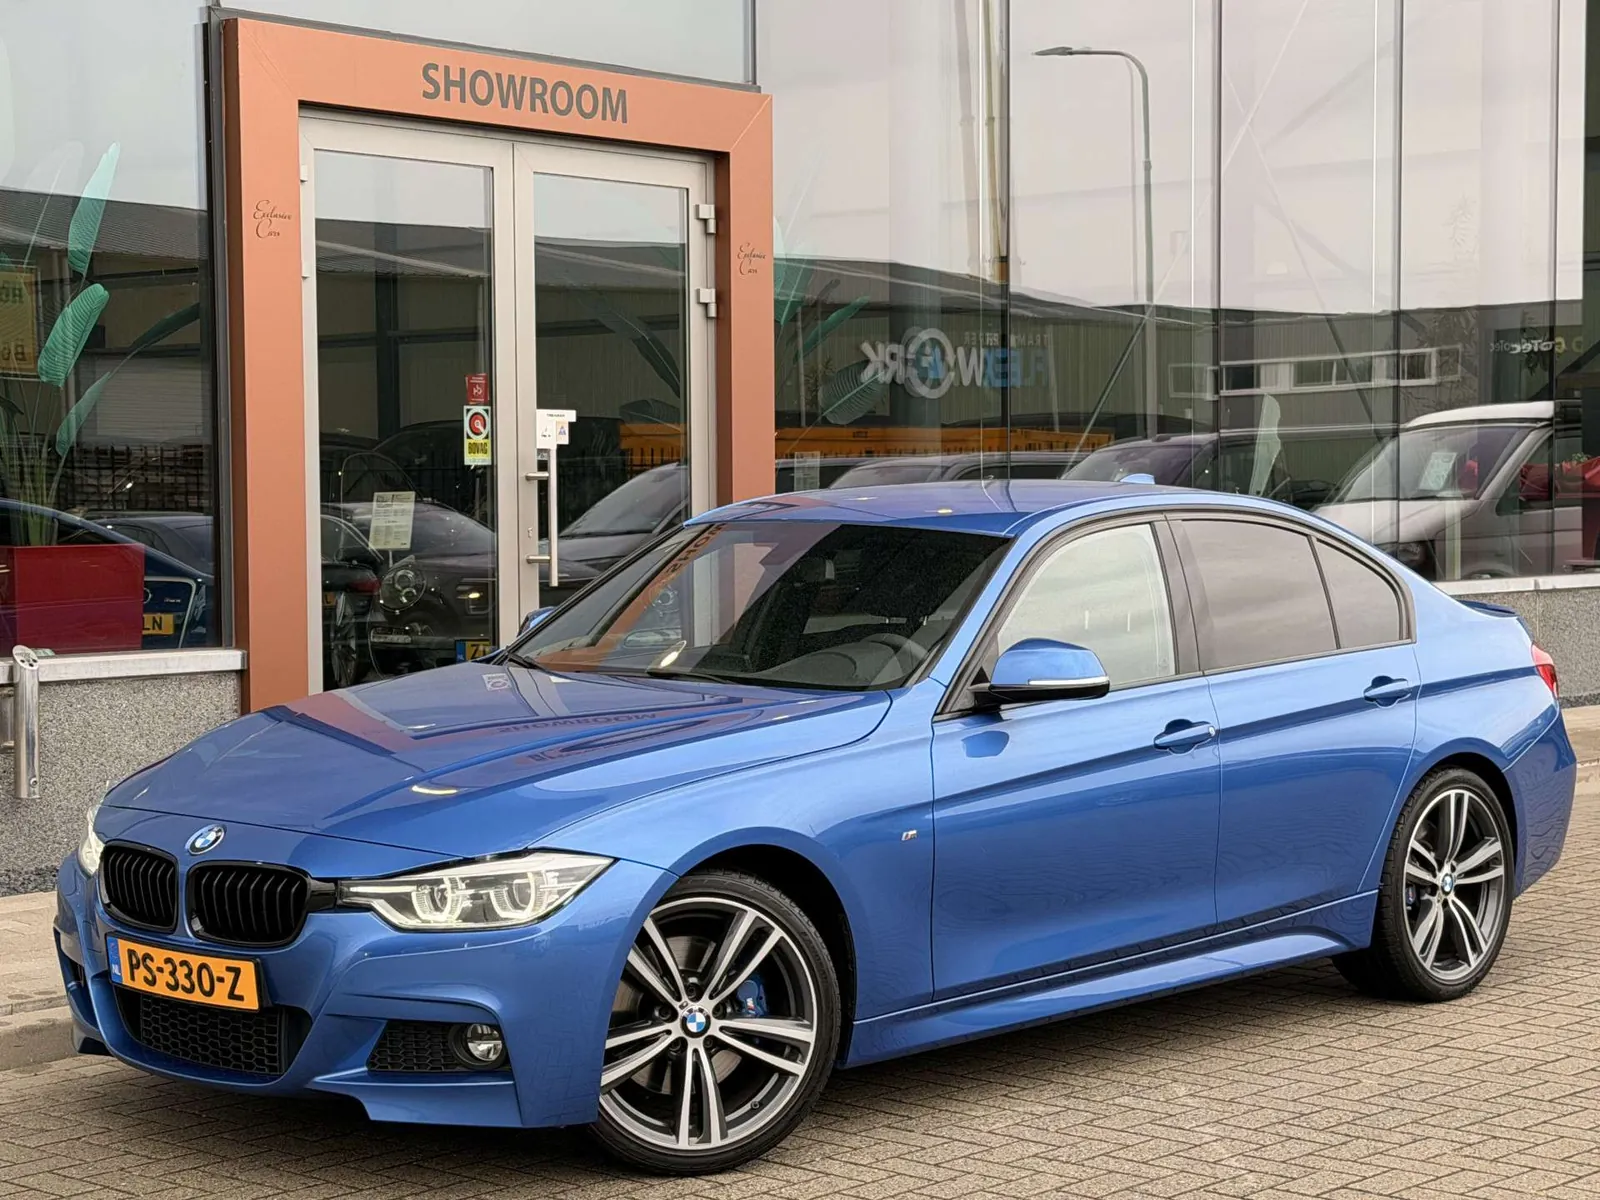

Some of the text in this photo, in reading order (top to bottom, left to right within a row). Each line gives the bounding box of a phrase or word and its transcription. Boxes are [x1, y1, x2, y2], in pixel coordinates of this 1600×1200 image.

[422, 62, 628, 124] SHOWROOM
[468, 442, 488, 455] BOVAG
[127, 948, 245, 1002] PS-330-Z
